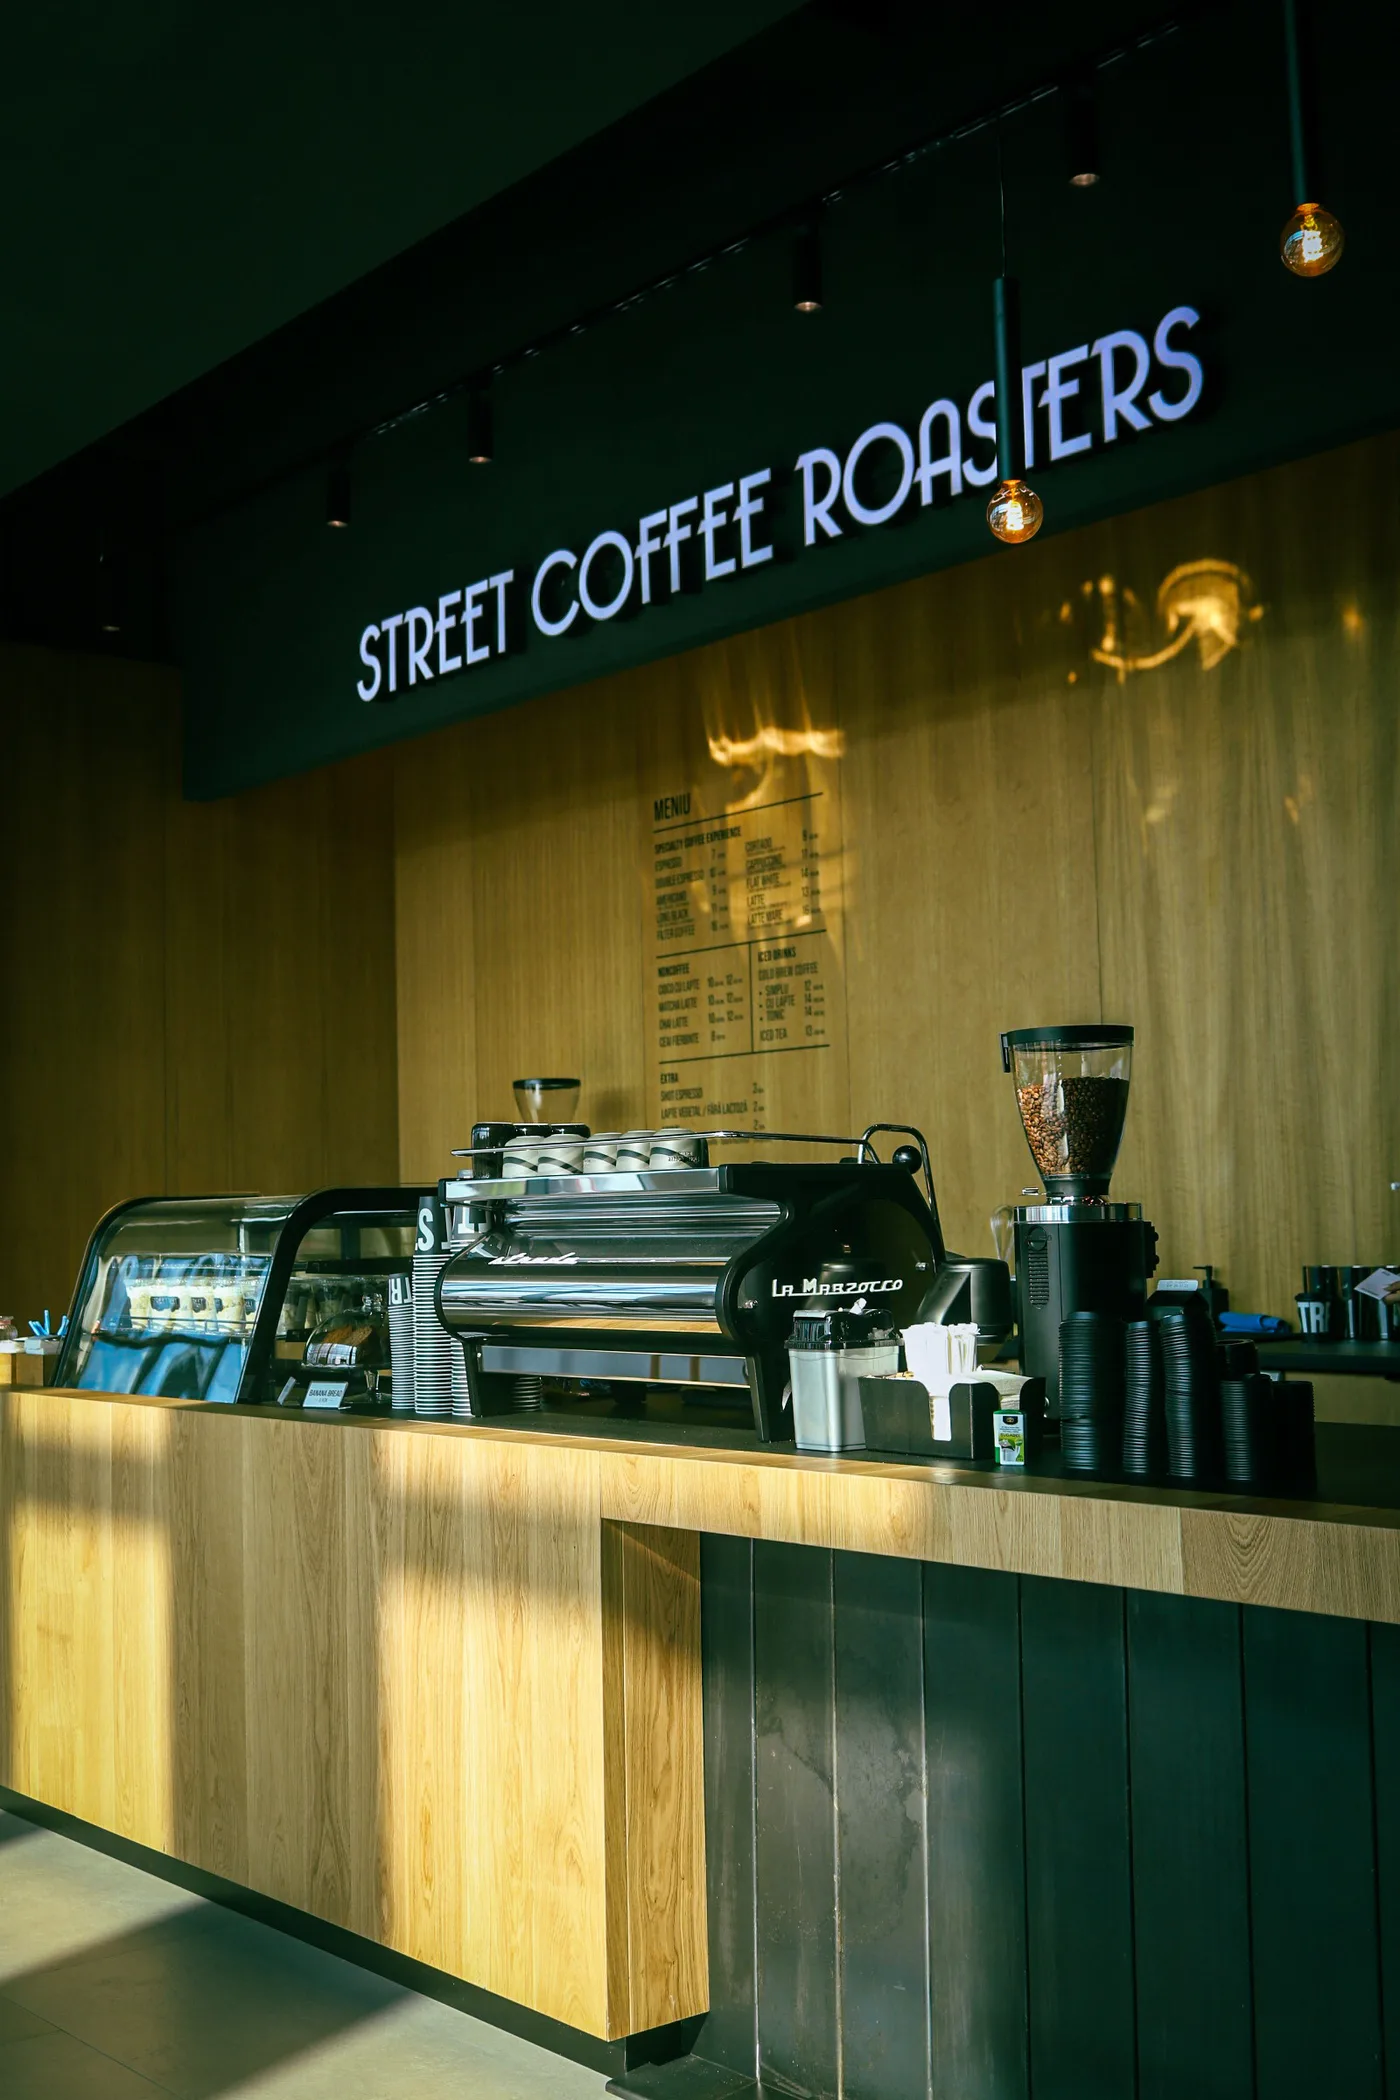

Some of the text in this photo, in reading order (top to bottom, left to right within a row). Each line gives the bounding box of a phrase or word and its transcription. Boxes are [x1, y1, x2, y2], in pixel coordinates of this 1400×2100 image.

[356, 306, 1204, 702] STREET COFFEE ROASTERS
[654, 793, 691, 821] MENIU
[747, 894, 765, 907] LATTE
[660, 1072, 678, 1084] EXTRA
[309, 1389, 342, 1397] BANANA BREAD
